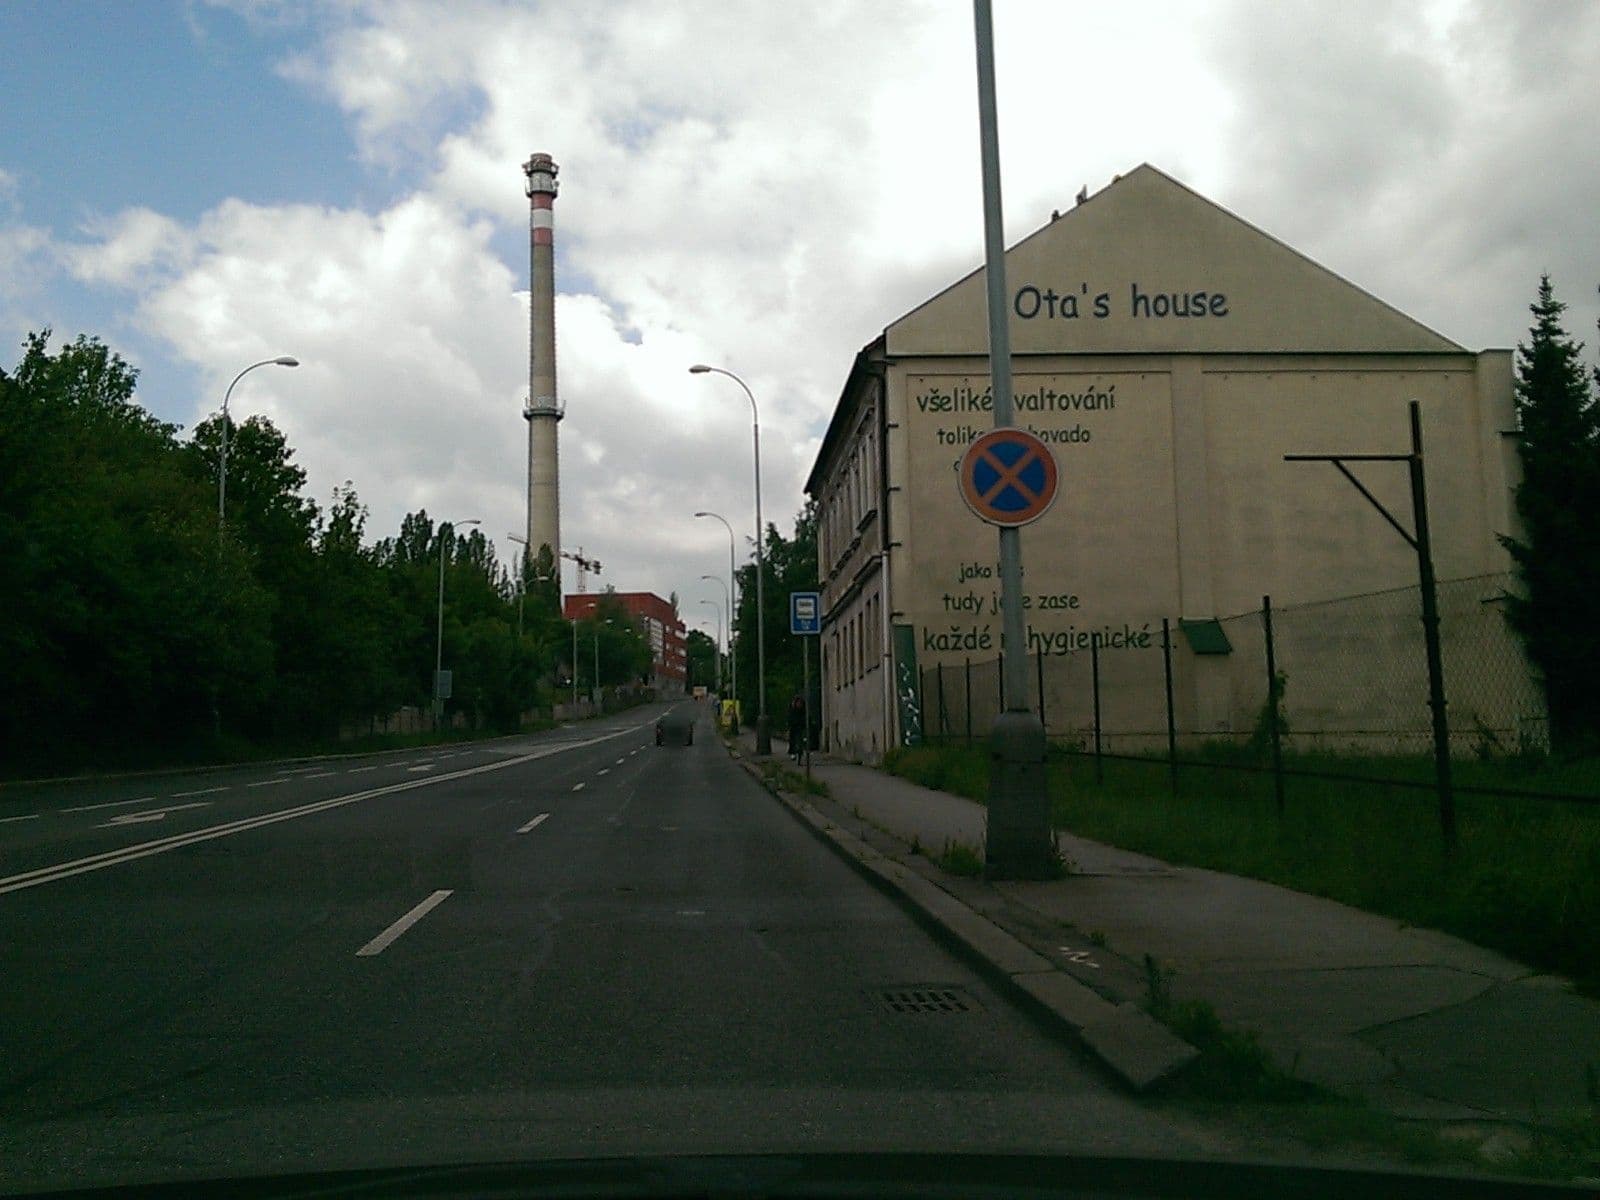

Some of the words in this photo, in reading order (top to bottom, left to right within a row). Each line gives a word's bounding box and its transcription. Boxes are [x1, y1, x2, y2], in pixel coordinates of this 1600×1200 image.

[1014, 283, 1110, 319] Ota's
[1131, 283, 1229, 318] house
[916, 385, 993, 412] všeliké
[1014, 385, 1116, 411] valtování
[958, 562, 992, 584] jako
[942, 590, 984, 616] tudy
[1037, 594, 1080, 610] zase
[923, 624, 992, 652] každé
